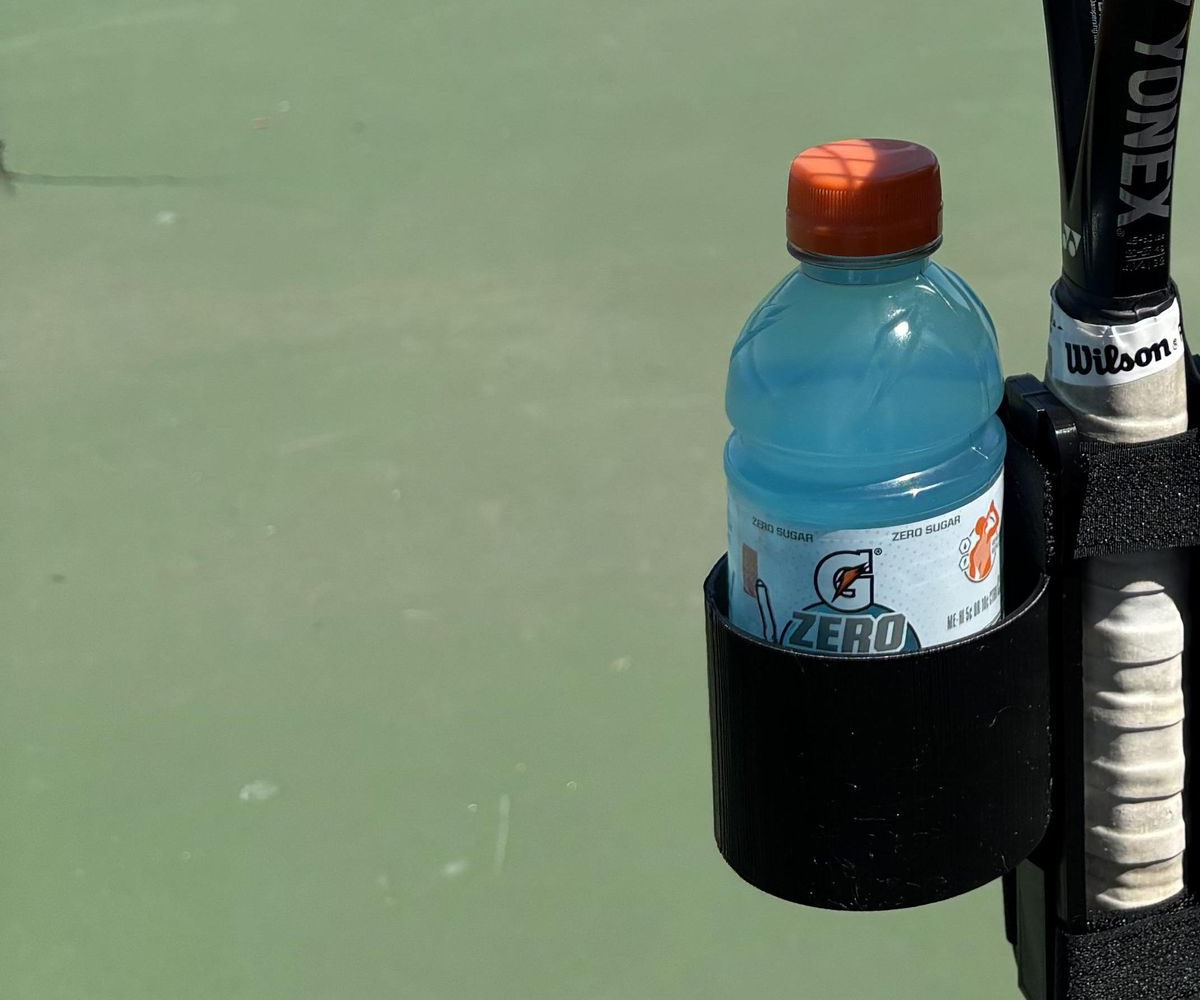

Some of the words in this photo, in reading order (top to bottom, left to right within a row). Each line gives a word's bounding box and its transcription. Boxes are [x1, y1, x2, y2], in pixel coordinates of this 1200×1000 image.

[1117, 22, 1190, 228] YONEX
[1065, 338, 1172, 375] Wilson
[752, 517, 774, 535] ZERO
[776, 526, 814, 543] SUGAR
[891, 528, 923, 542] ZERO
[925, 515, 961, 535] SUGAR
[787, 612, 907, 653] ZERO
